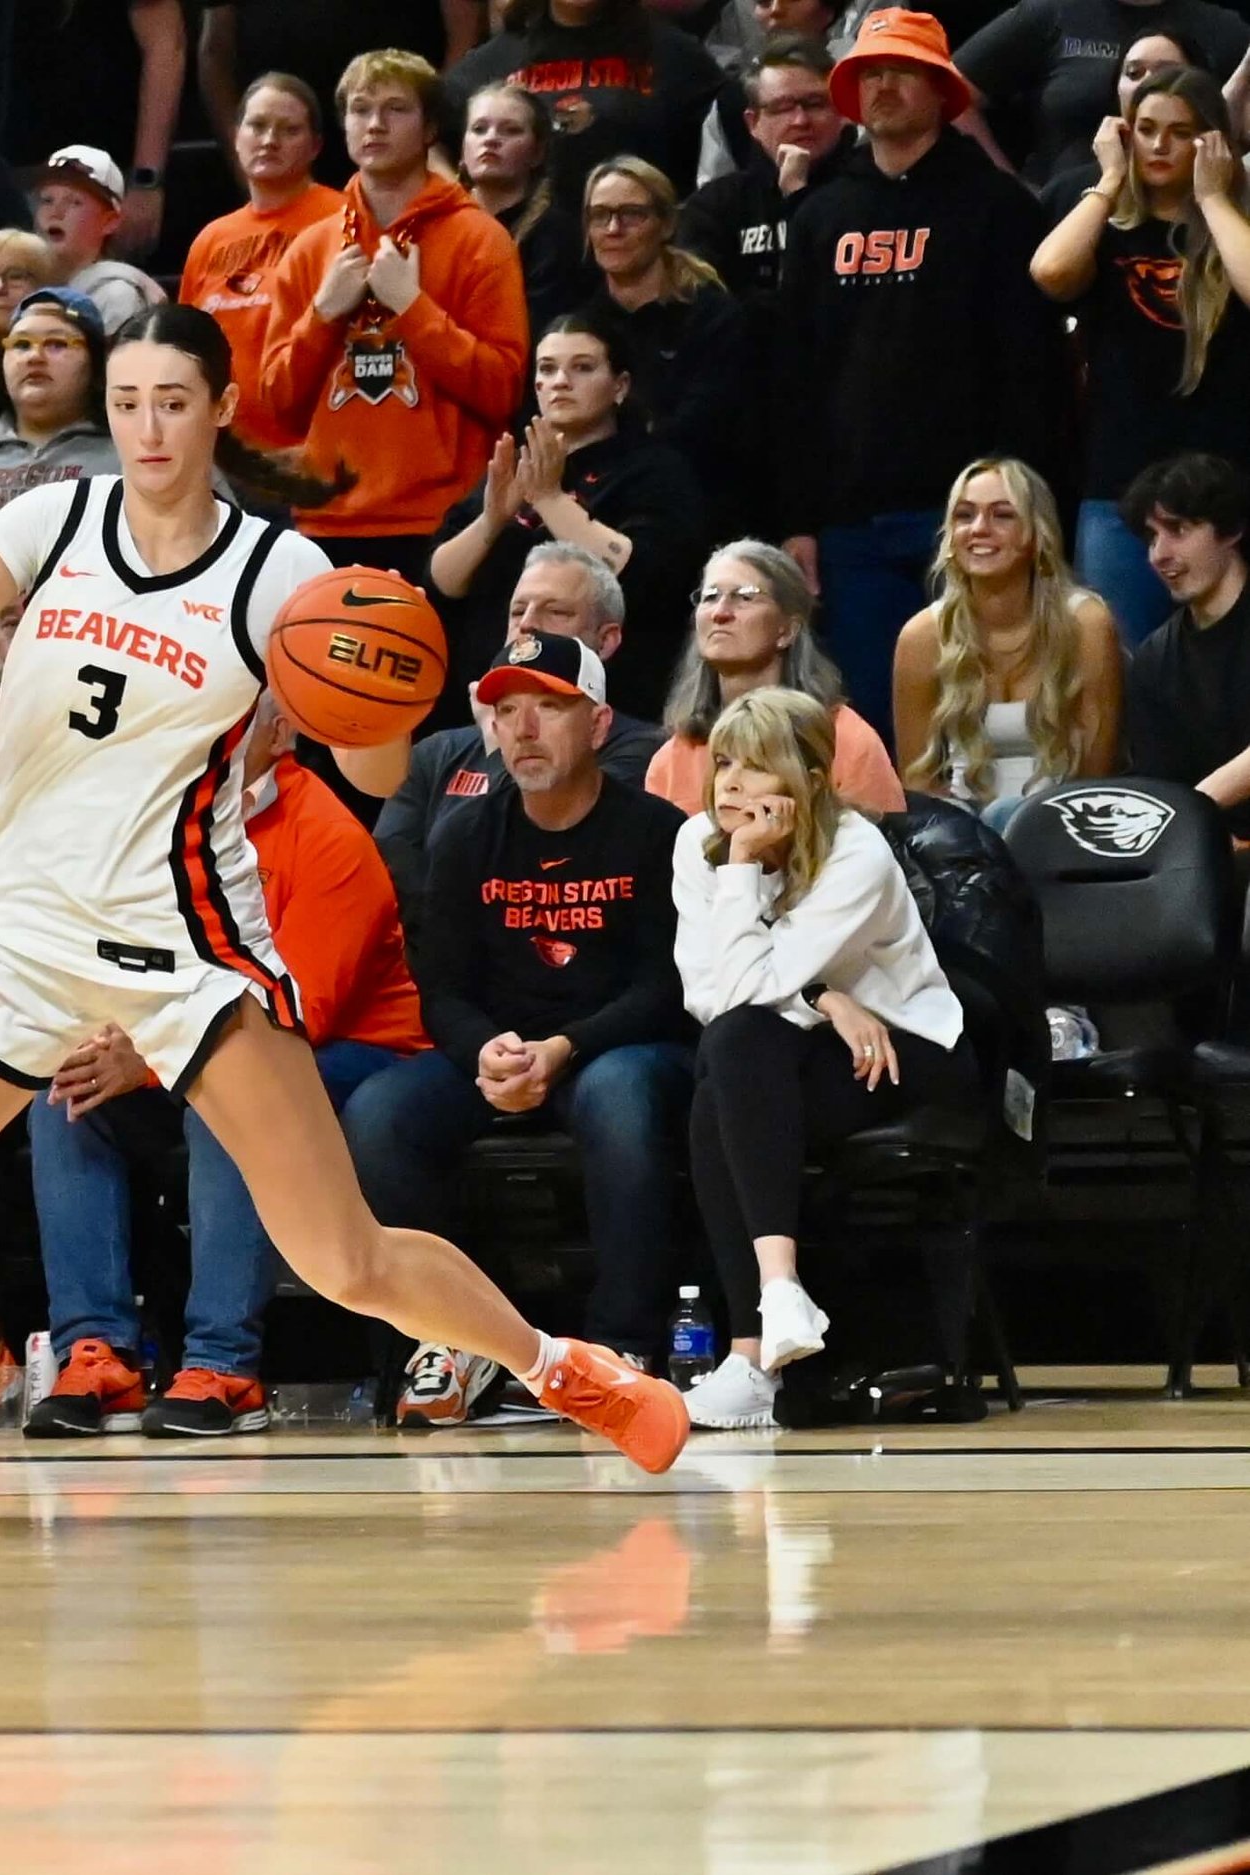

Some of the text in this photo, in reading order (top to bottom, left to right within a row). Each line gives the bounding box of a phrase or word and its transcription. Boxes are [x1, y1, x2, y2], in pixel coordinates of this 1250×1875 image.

[834, 227, 931, 276] OSU
[354, 363, 394, 378] DAM
[182, 600, 225, 623] WCC
[36, 608, 208, 690] BEAVERS
[327, 631, 423, 684] ELITE
[68, 664, 128, 741] 3
[481, 876, 634, 905] OREGON STATE
[505, 905, 604, 932] BEAVERS
[30, 1359, 42, 1402] LTRA
